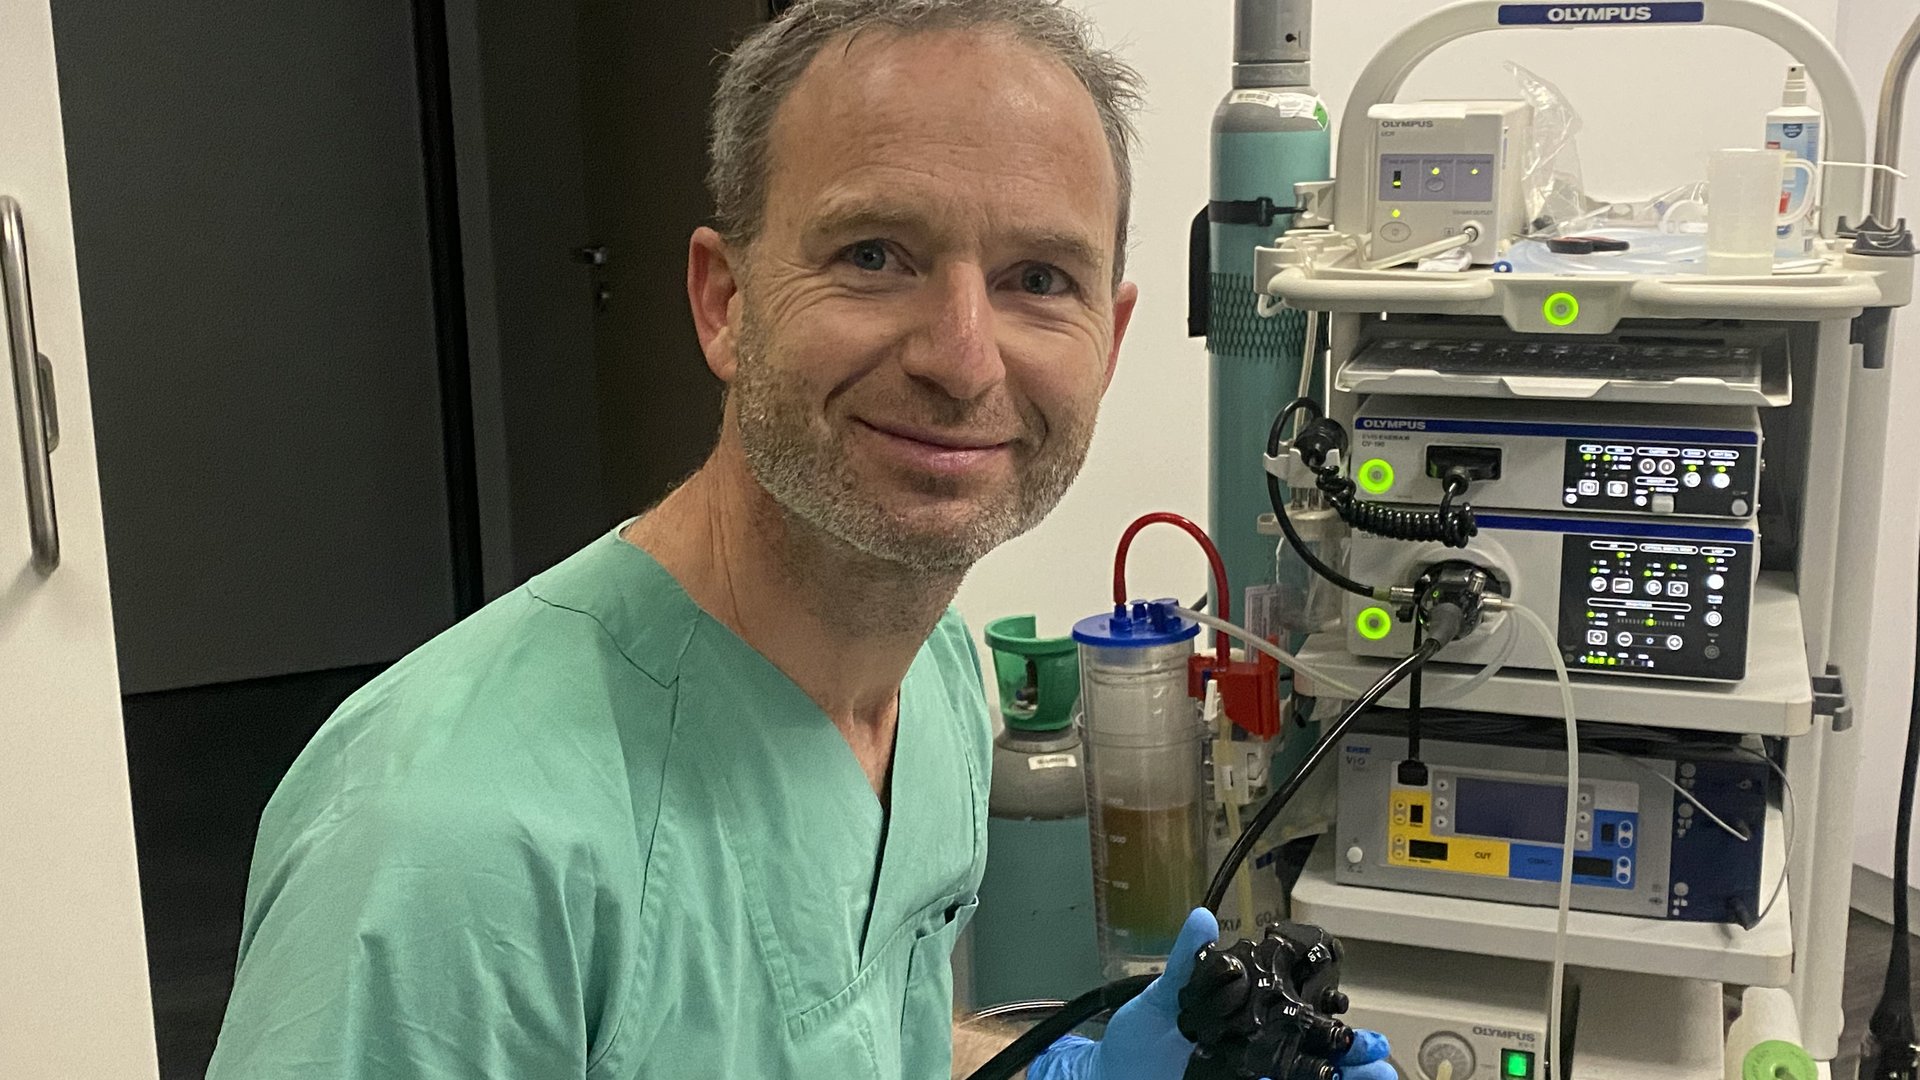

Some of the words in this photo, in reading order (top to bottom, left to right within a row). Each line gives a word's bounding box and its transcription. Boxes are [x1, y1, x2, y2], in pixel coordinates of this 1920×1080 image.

[1547, 7, 1652, 22] OLYMPUS
[1381, 120, 1434, 128] OLYMPUS
[1363, 419, 1426, 430] OLYMPUS
[1474, 851, 1492, 860] CUT
[1472, 1026, 1536, 1042] OLYMPUS
